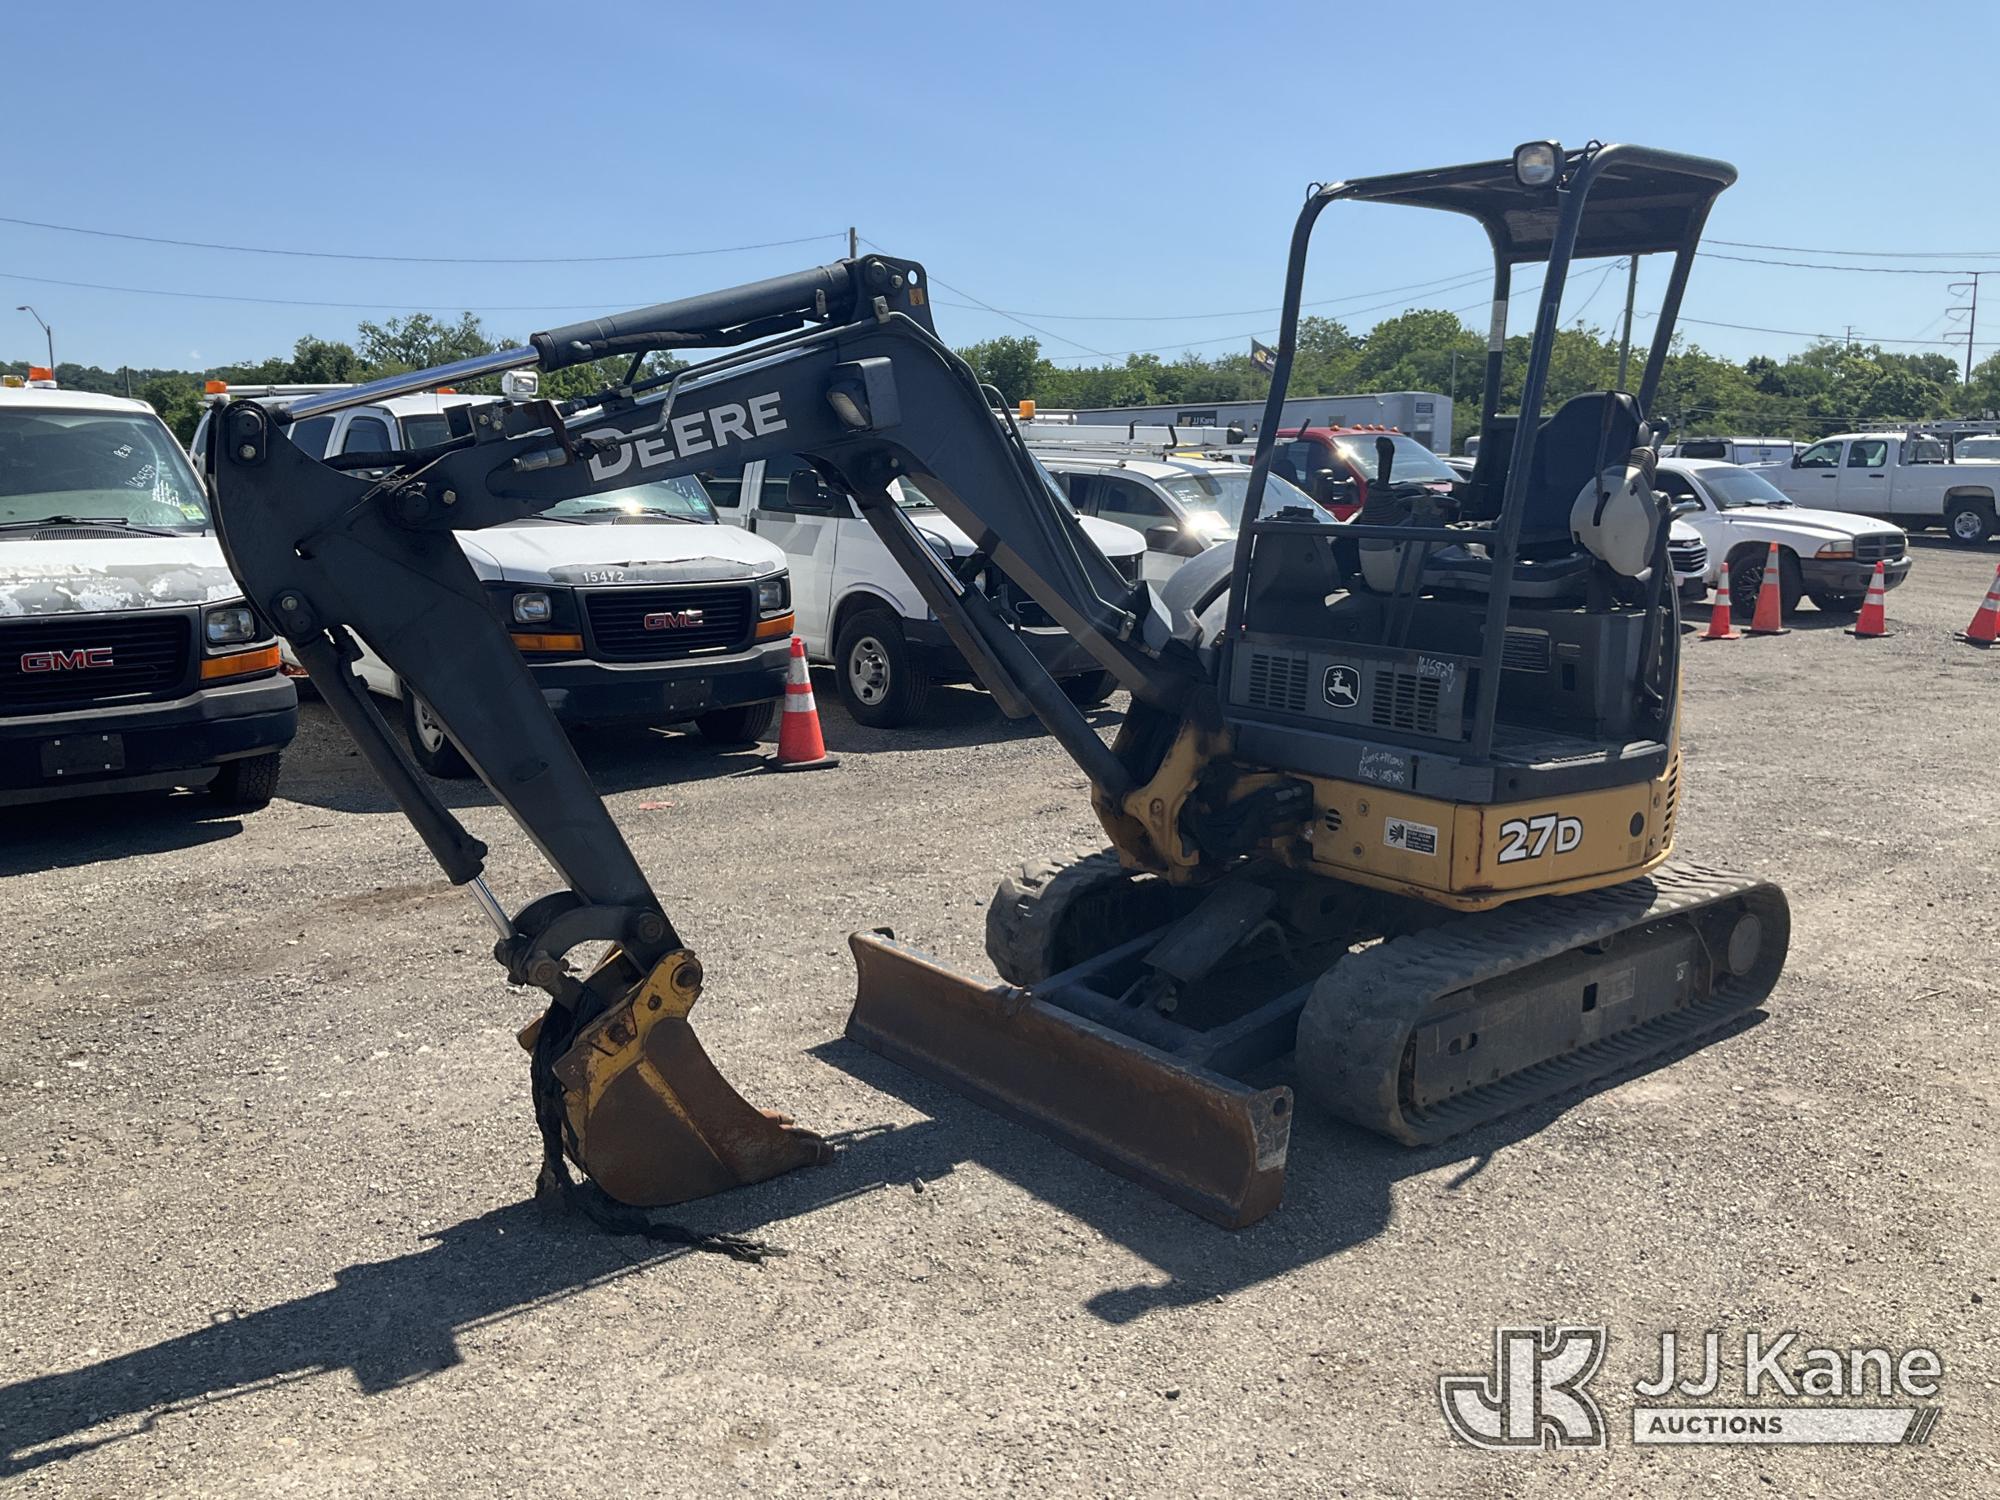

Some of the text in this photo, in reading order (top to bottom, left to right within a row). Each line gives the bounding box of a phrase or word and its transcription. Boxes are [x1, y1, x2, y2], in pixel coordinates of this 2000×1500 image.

[581, 391, 787, 482] DEERE
[643, 608, 703, 631] GMC
[20, 646, 114, 673] GMC
[1497, 812, 1583, 865] 27D
